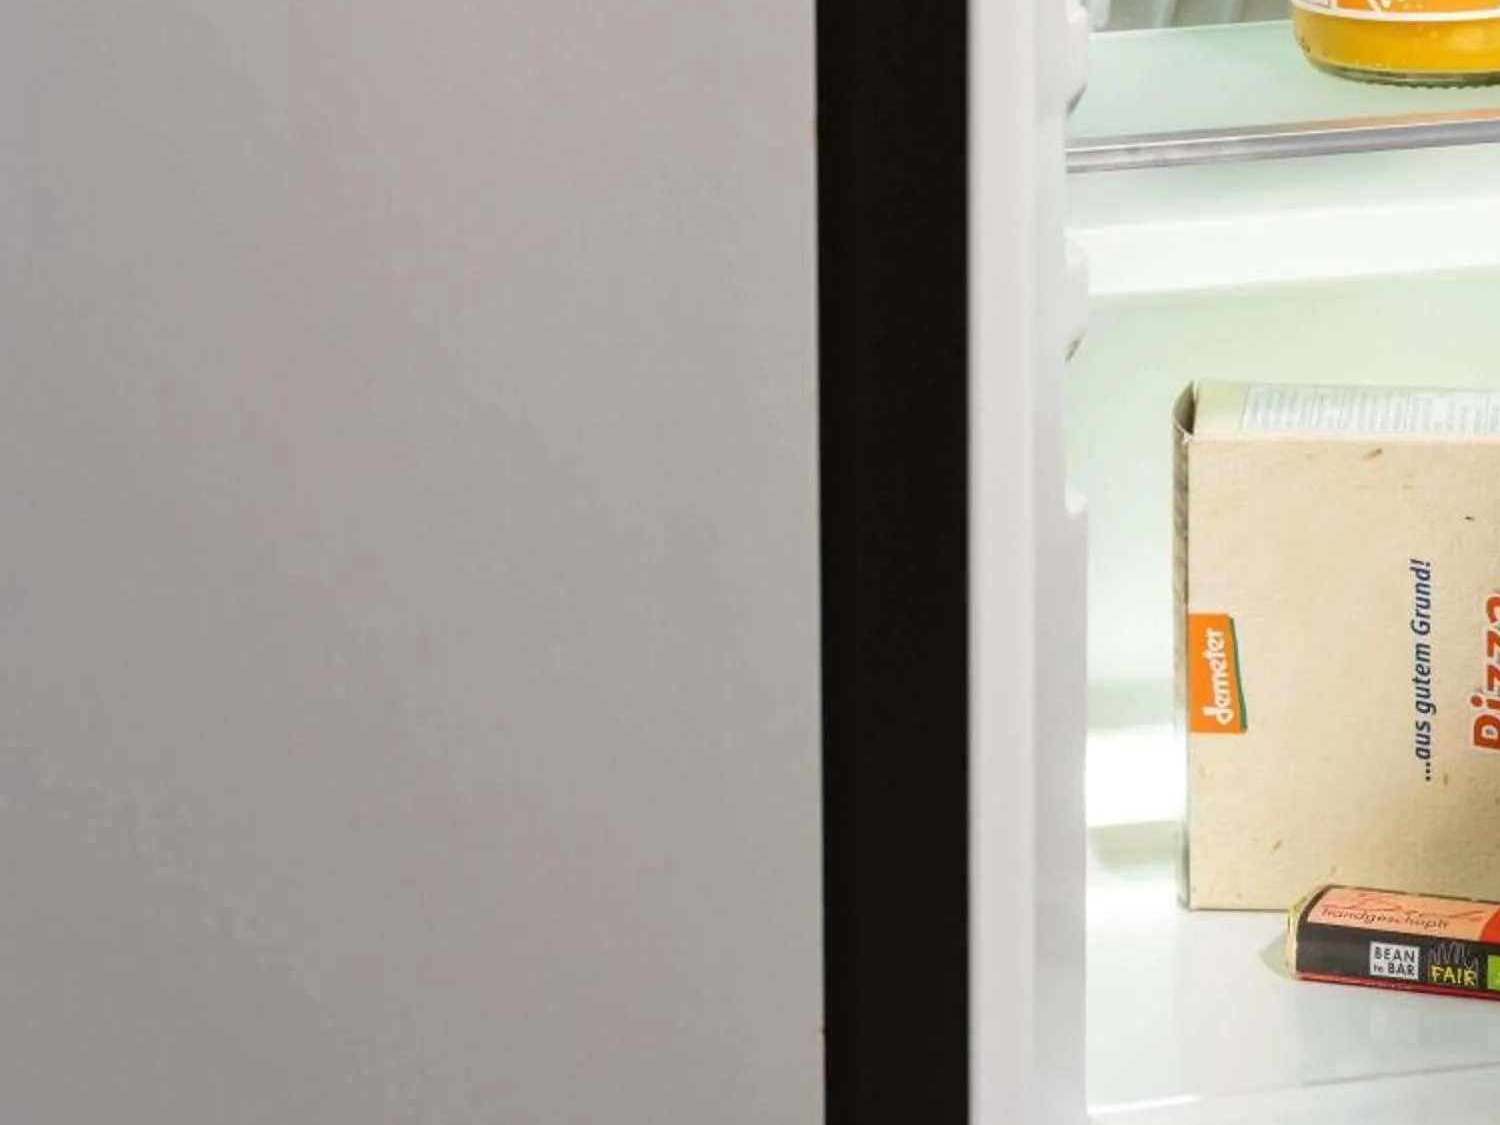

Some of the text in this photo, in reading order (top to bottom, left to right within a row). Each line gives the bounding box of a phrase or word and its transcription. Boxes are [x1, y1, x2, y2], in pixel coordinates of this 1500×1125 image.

[1409, 558, 1431, 636] Grund!
[1202, 627, 1234, 726] demeter
[1412, 643, 1437, 716] gutem
[1375, 946, 1416, 963] BEAN
[1387, 961, 1416, 976] BAR
[1430, 963, 1477, 987] FAIR
